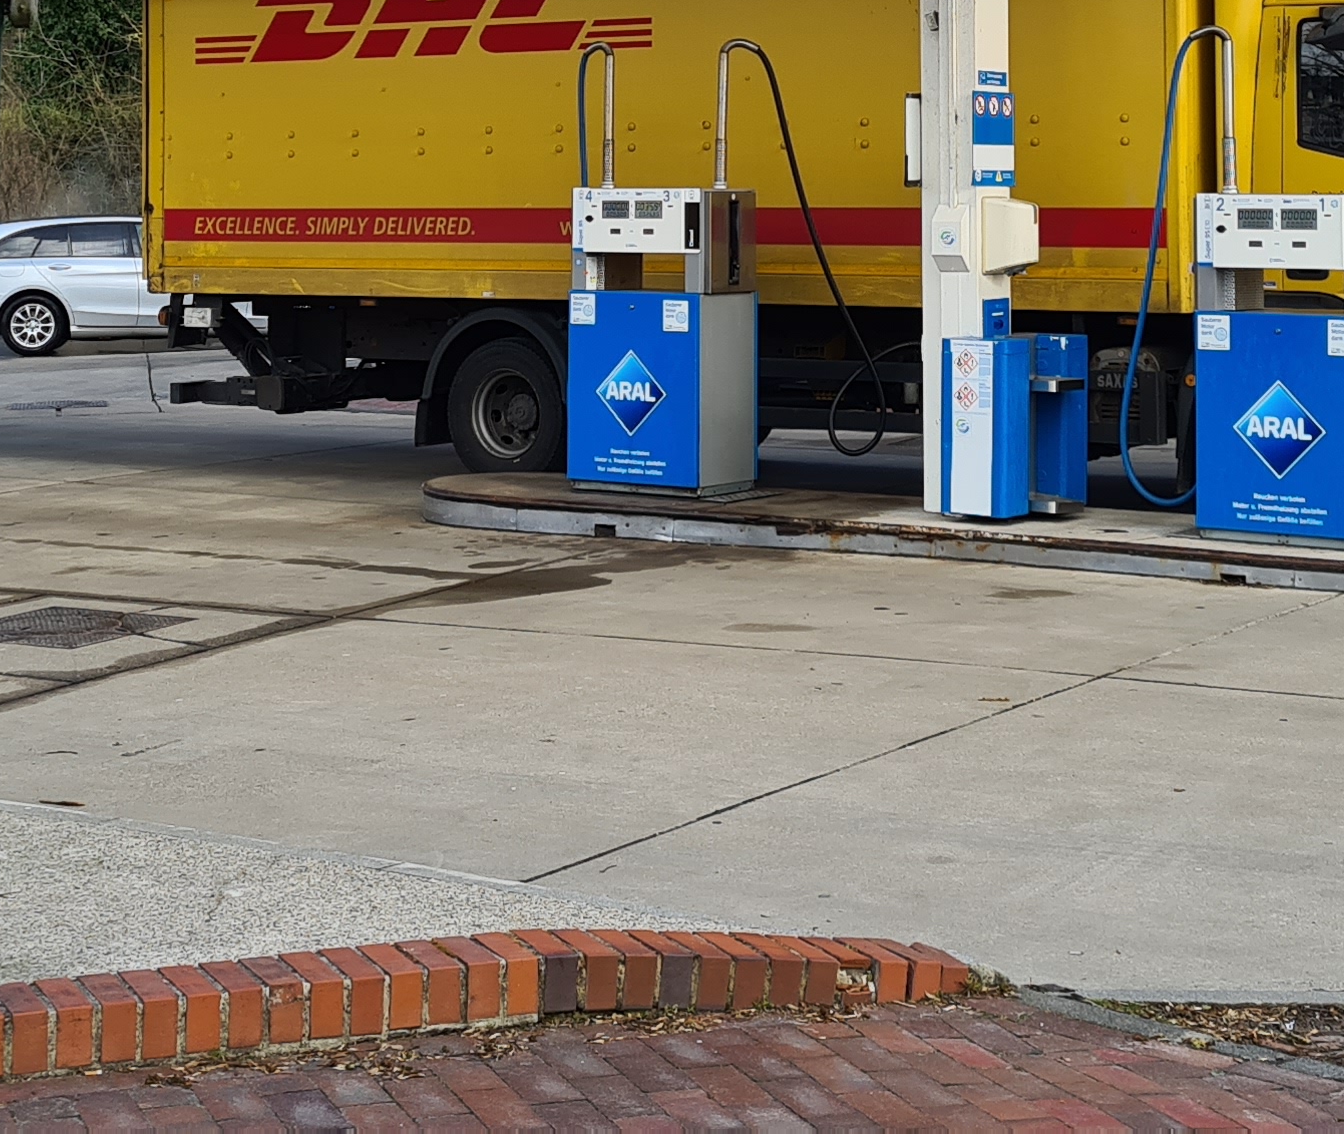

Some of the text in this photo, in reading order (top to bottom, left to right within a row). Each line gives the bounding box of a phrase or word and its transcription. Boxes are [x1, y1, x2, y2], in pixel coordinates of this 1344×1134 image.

[585, 190, 592, 202] 4
[663, 190, 670, 202] 3
[1216, 197, 1225, 212] 2
[1319, 198, 1325, 212] 1
[194, 216, 476, 236] EXCELLENCE. SIMPLY DELIVERED.
[605, 380, 656, 403] ARAL
[1246, 415, 1313, 442] ARAL
